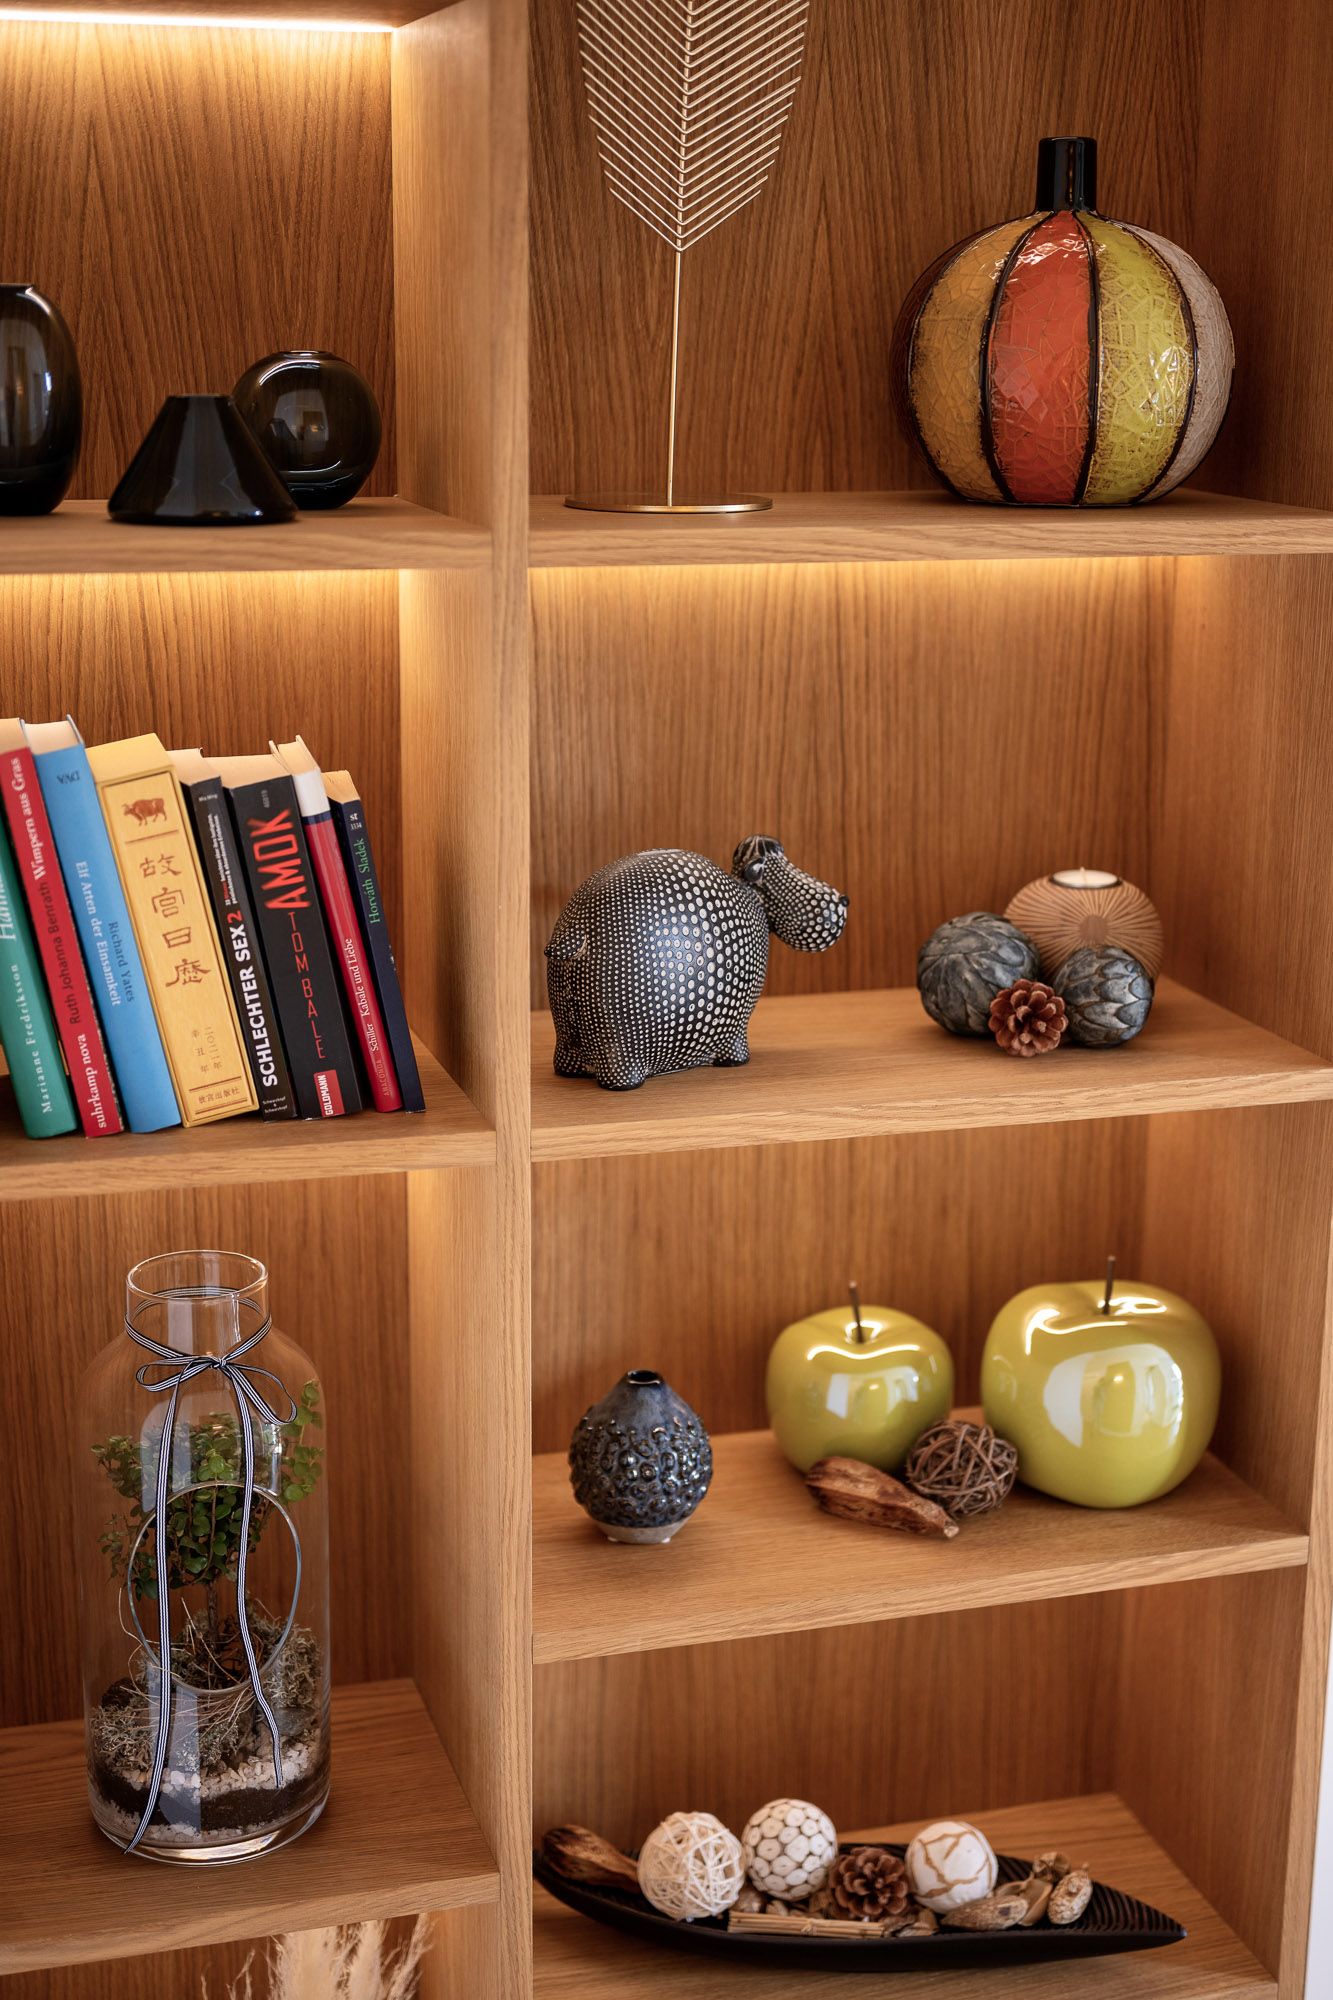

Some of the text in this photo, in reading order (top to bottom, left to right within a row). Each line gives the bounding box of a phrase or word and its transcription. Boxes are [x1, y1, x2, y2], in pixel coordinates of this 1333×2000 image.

[11, 757, 46, 880] Wimpern aus Gras
[247, 808, 311, 909] AMOK
[350, 812, 359, 821] st
[353, 838, 380, 923] Horváth Sladek
[39, 882, 80, 1025] Ruth Johanna Benrath
[76, 861, 121, 1006] Elf Arten der Einsamkeit
[108, 921, 135, 1002] Richard Yates
[344, 938, 370, 1017] Kabale und Liebe
[227, 910, 278, 1087] SCHLECHTER SEX 2
[288, 911, 326, 1059] TOM BALE
[11, 964, 53, 1114] Marianne Fredriksson
[77, 1034, 107, 1129] suhrkamp nova
[366, 1023, 379, 1052] Schiller
[316, 1074, 334, 1117] GOLDMANN
